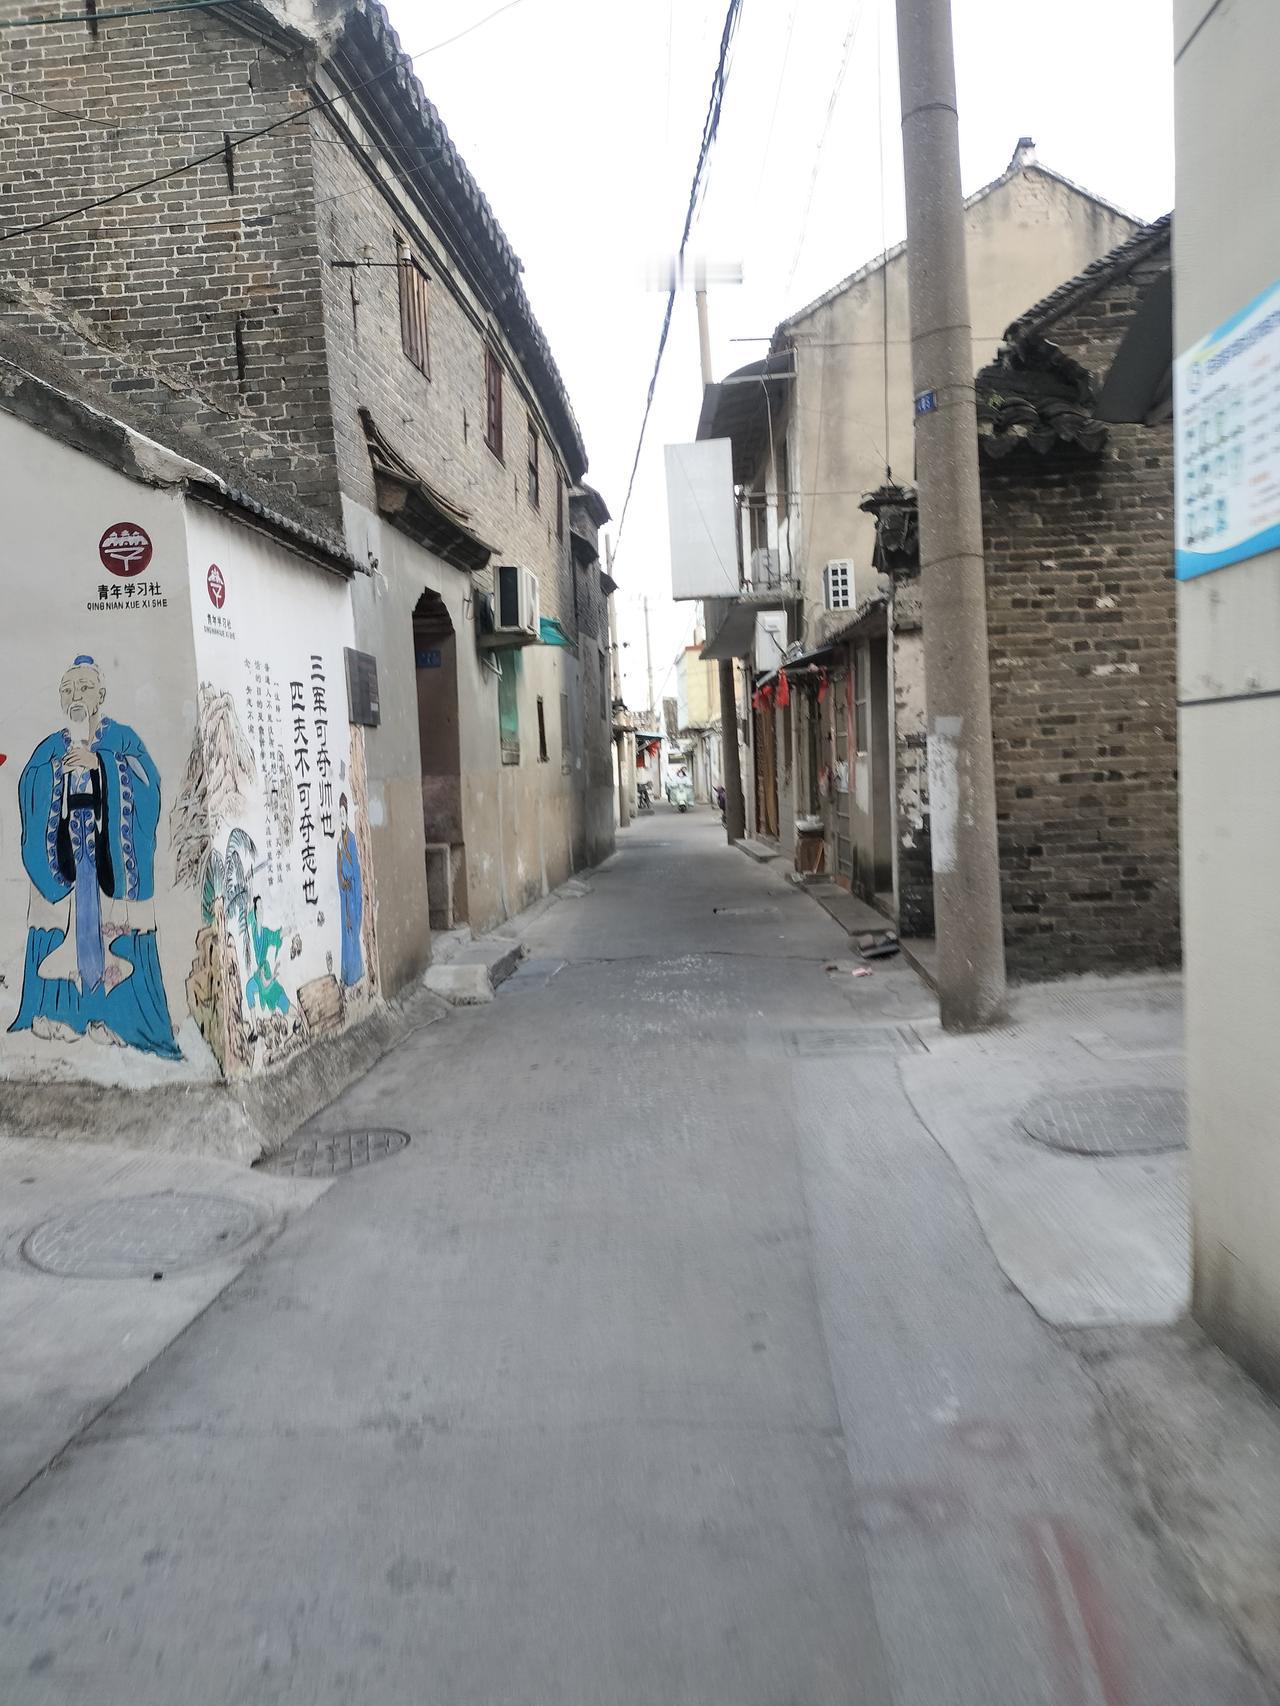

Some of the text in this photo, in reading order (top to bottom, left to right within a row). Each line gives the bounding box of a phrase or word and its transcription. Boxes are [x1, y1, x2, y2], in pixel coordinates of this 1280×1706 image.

[97, 581, 162, 600] 青年学习社
[106, 601, 124, 610] NIAN
[125, 600, 140, 609] XUE
[142, 599, 151, 608] XI
[152, 598, 168, 608] SHE
[290, 681, 319, 905] 匹夫不可夺志也
[310, 655, 335, 839] 三军可夺帅也
